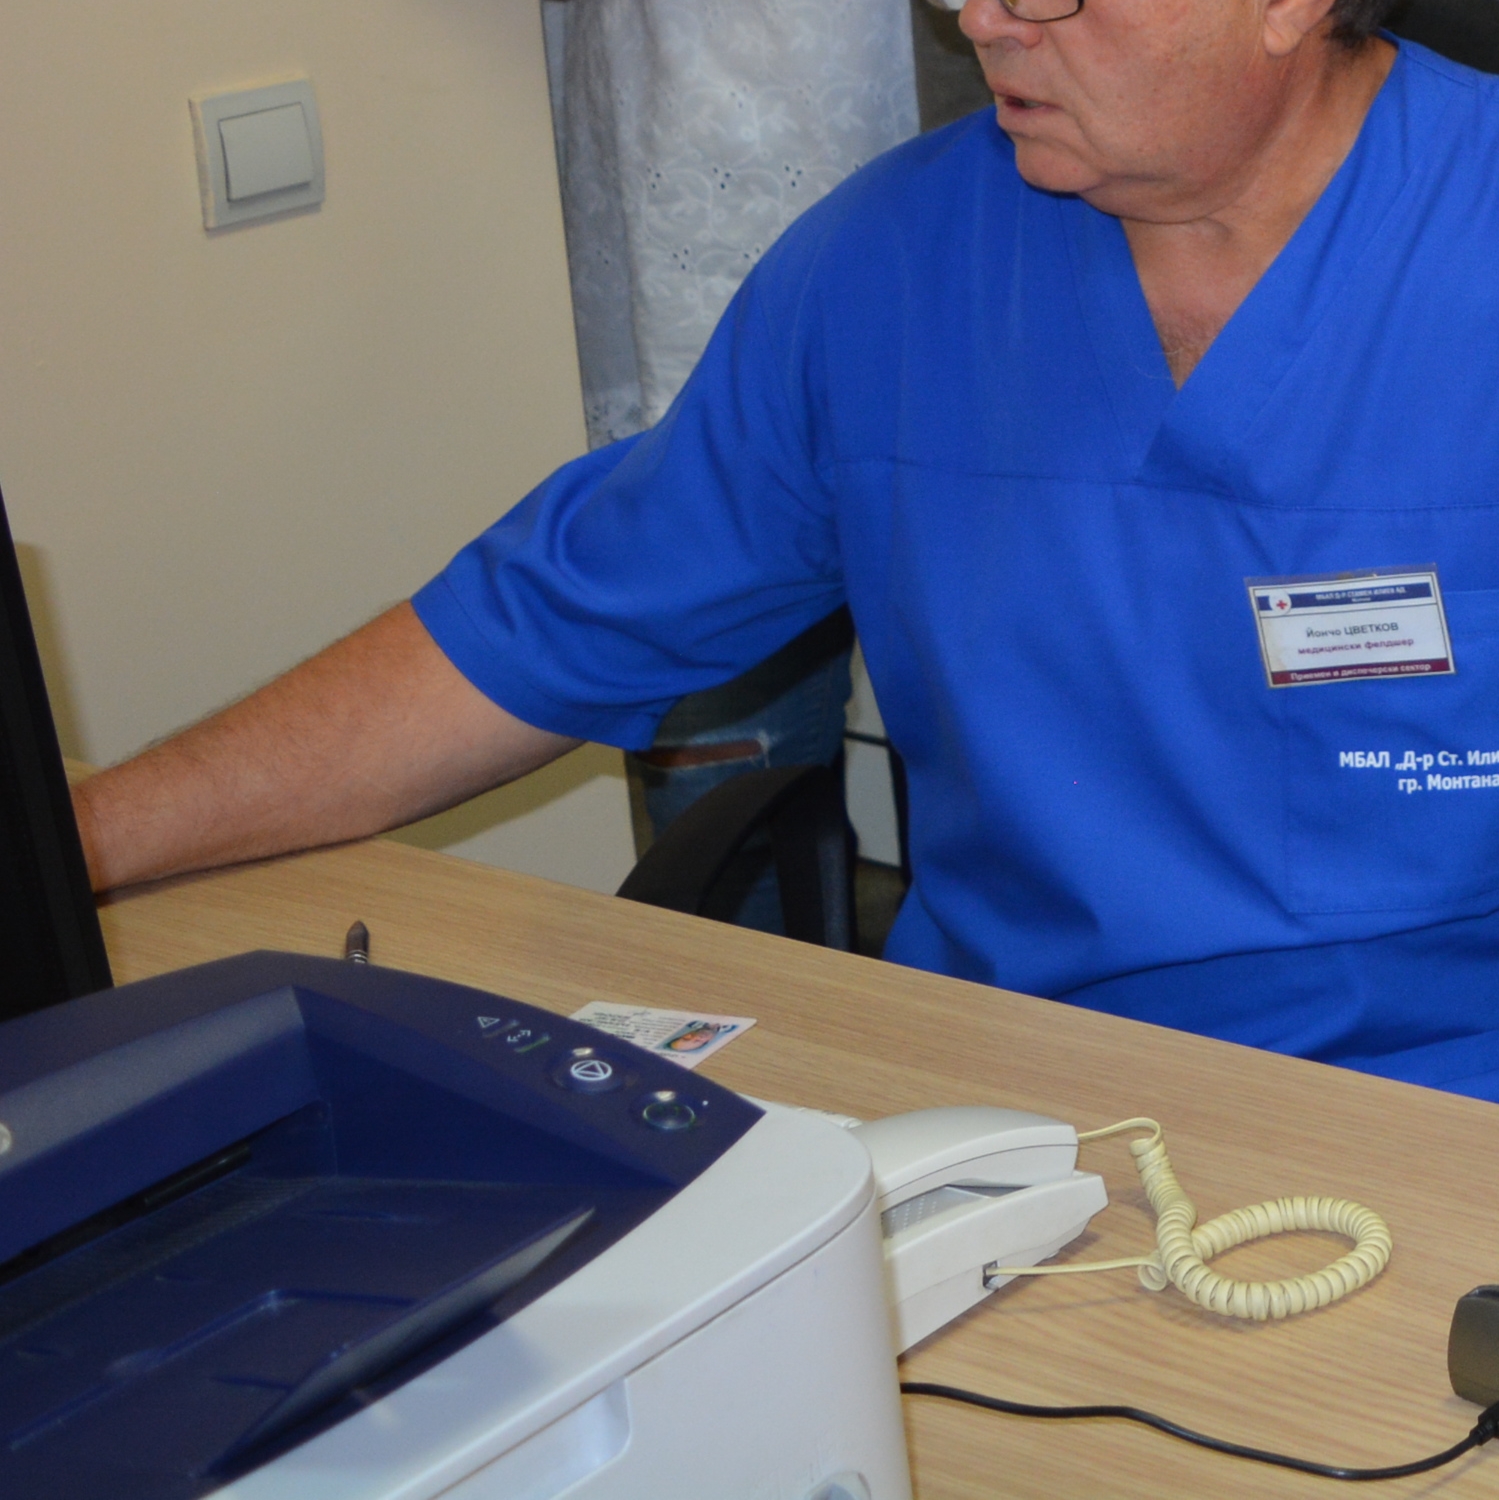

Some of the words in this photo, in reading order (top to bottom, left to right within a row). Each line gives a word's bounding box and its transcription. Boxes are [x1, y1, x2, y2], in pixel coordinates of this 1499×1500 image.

[1306, 627, 1342, 638] Йончо
[1344, 622, 1399, 636] ЦВЕТКОВ
[1298, 643, 1362, 655] медицински
[1364, 638, 1414, 650] фелдшер
[1400, 662, 1432, 673] сектор
[1339, 751, 1390, 768] МБАЛ
[1438, 750, 1464, 766] Ст.
[1398, 777, 1423, 794] гр.
